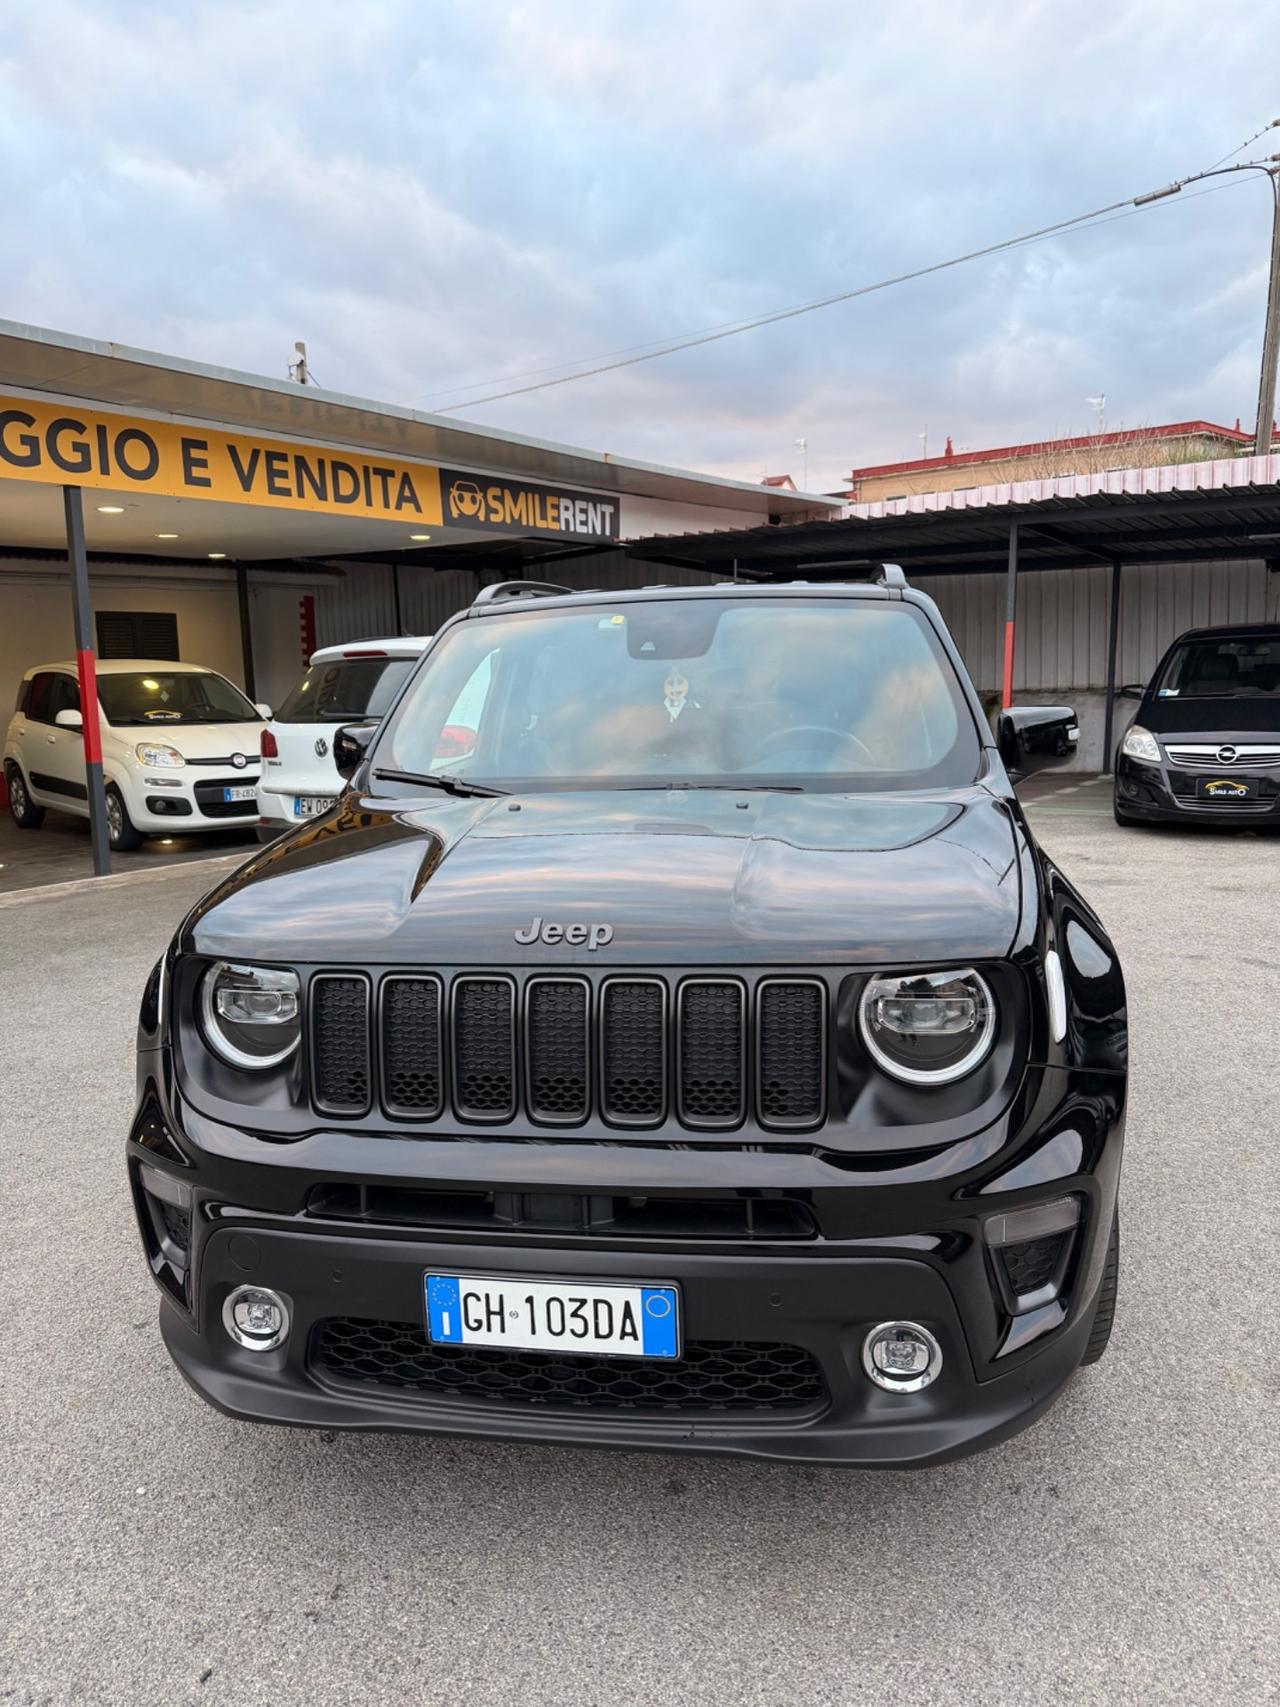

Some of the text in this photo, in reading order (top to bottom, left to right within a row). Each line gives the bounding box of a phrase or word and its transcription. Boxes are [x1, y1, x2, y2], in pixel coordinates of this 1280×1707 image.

[0, 410, 423, 514] GGIO E VENDITA
[514, 917, 614, 952] Jeep
